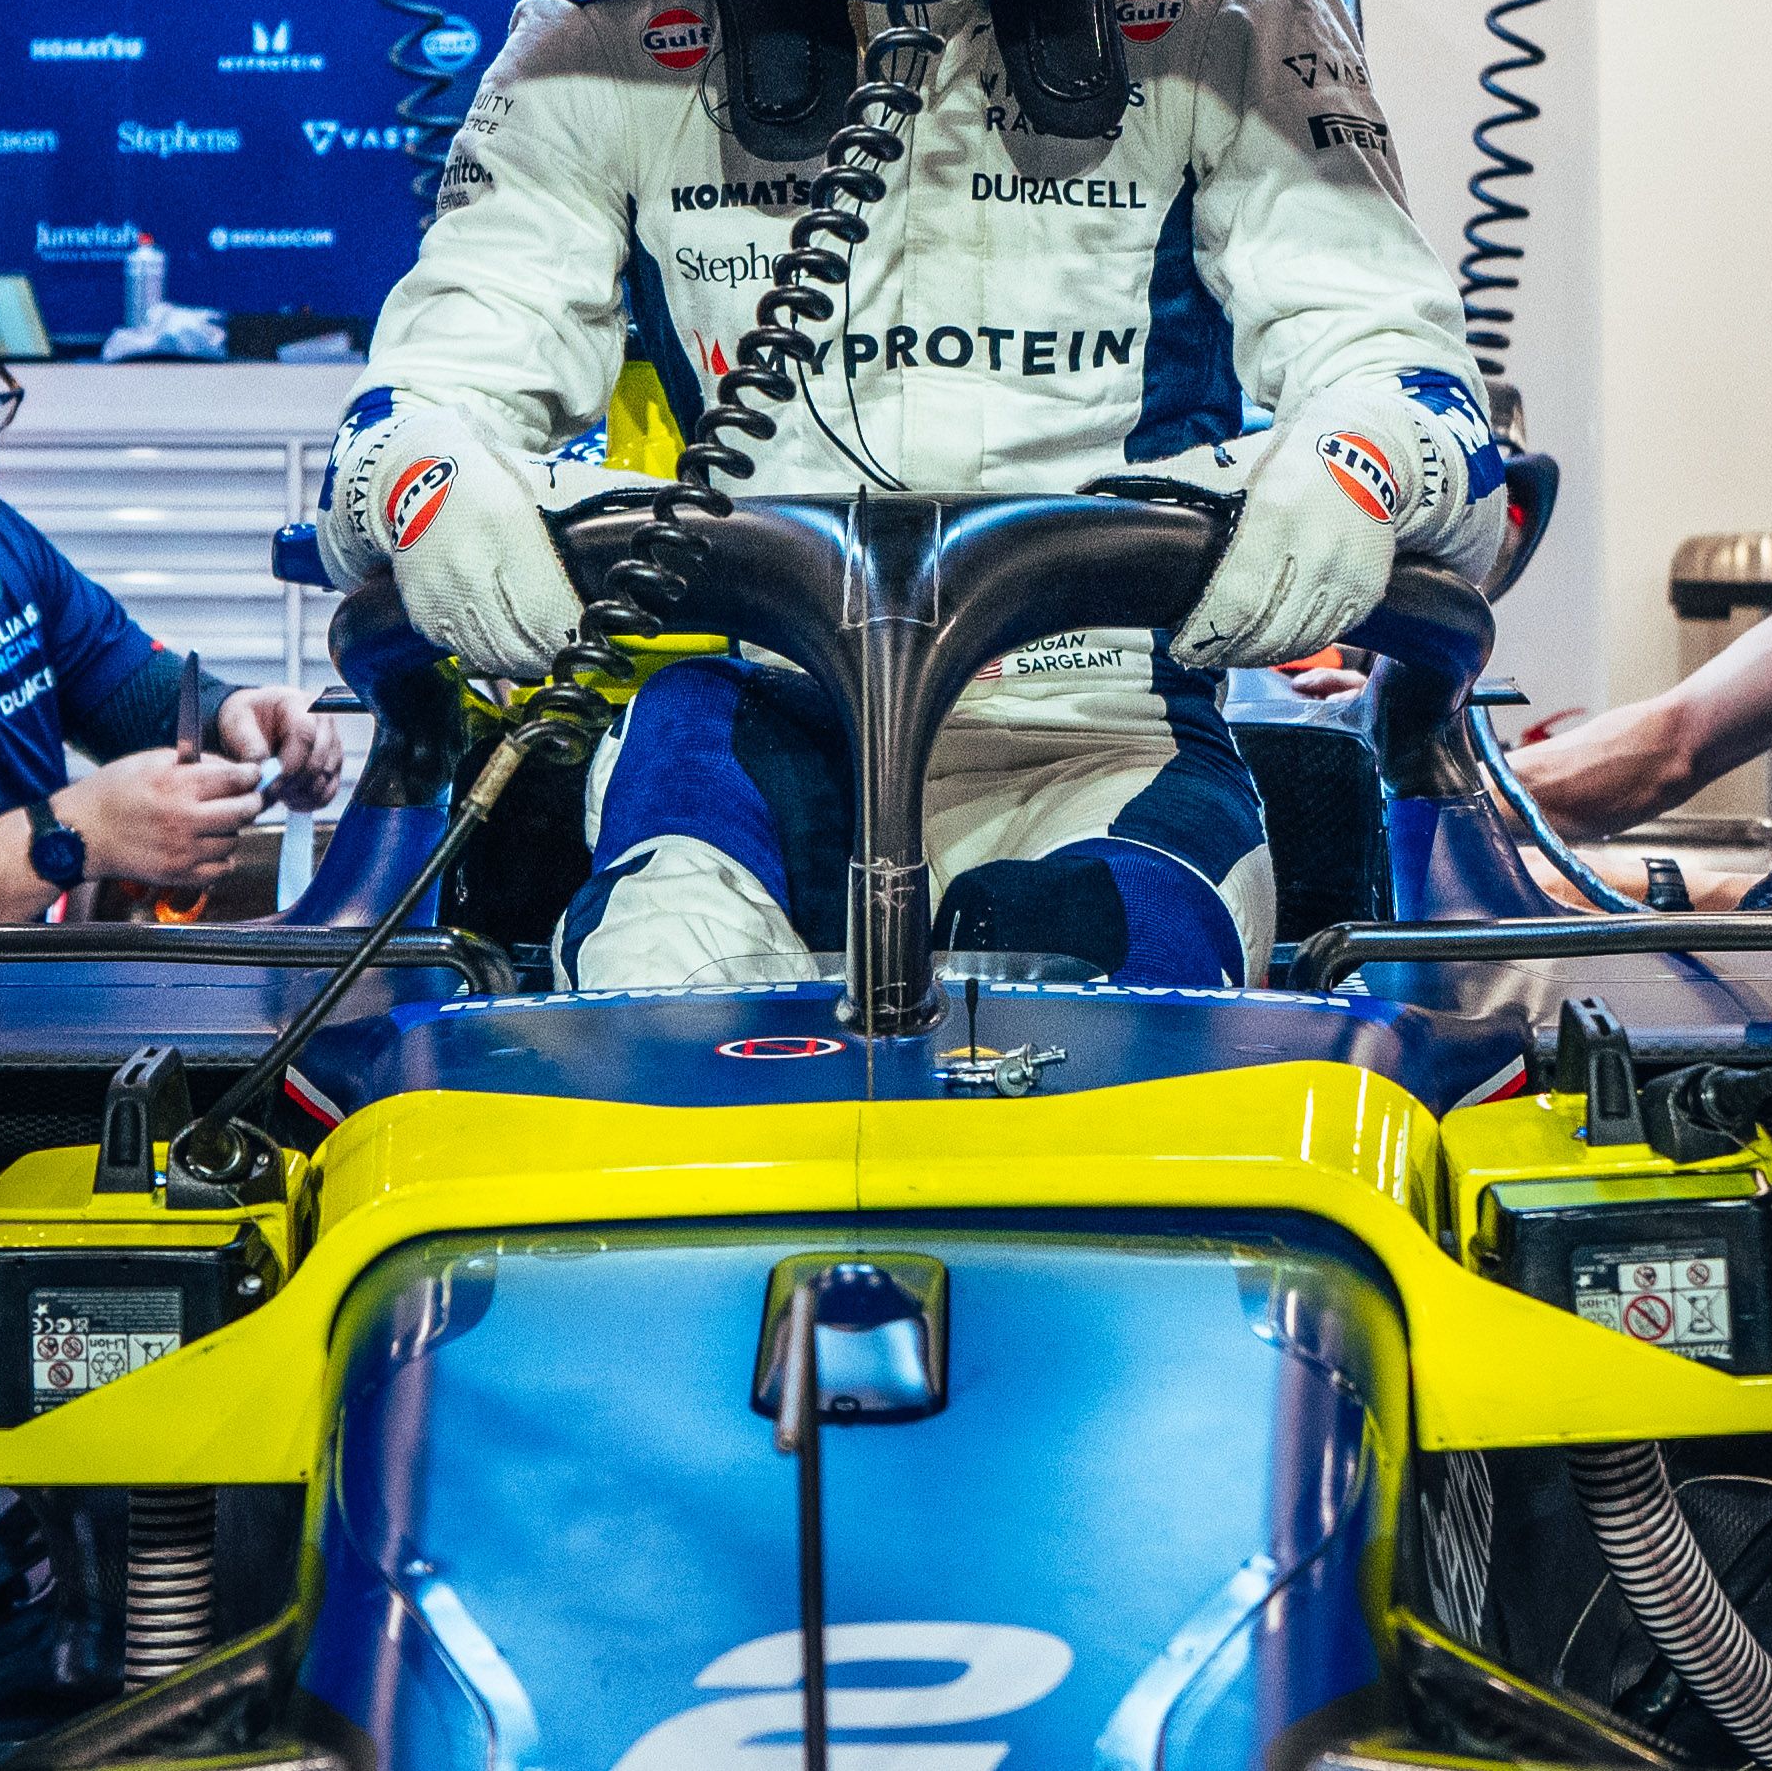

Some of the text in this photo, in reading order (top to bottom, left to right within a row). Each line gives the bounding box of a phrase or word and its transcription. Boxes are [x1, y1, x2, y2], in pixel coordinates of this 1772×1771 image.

[1116, 0, 1183, 23] Gulf
[643, 26, 712, 51] Gulf
[1324, 60, 1368, 86] VAS
[671, 172, 812, 213] KOMATS
[971, 172, 1147, 210] DURACELL
[675, 241, 784, 290] Steph
[1016, 648, 1123, 675] SARGEANT
[438, 983, 799, 1013] KOMATSU
[990, 973, 1352, 1008] KOMATSU
[611, 1620, 1075, 1771] 2
